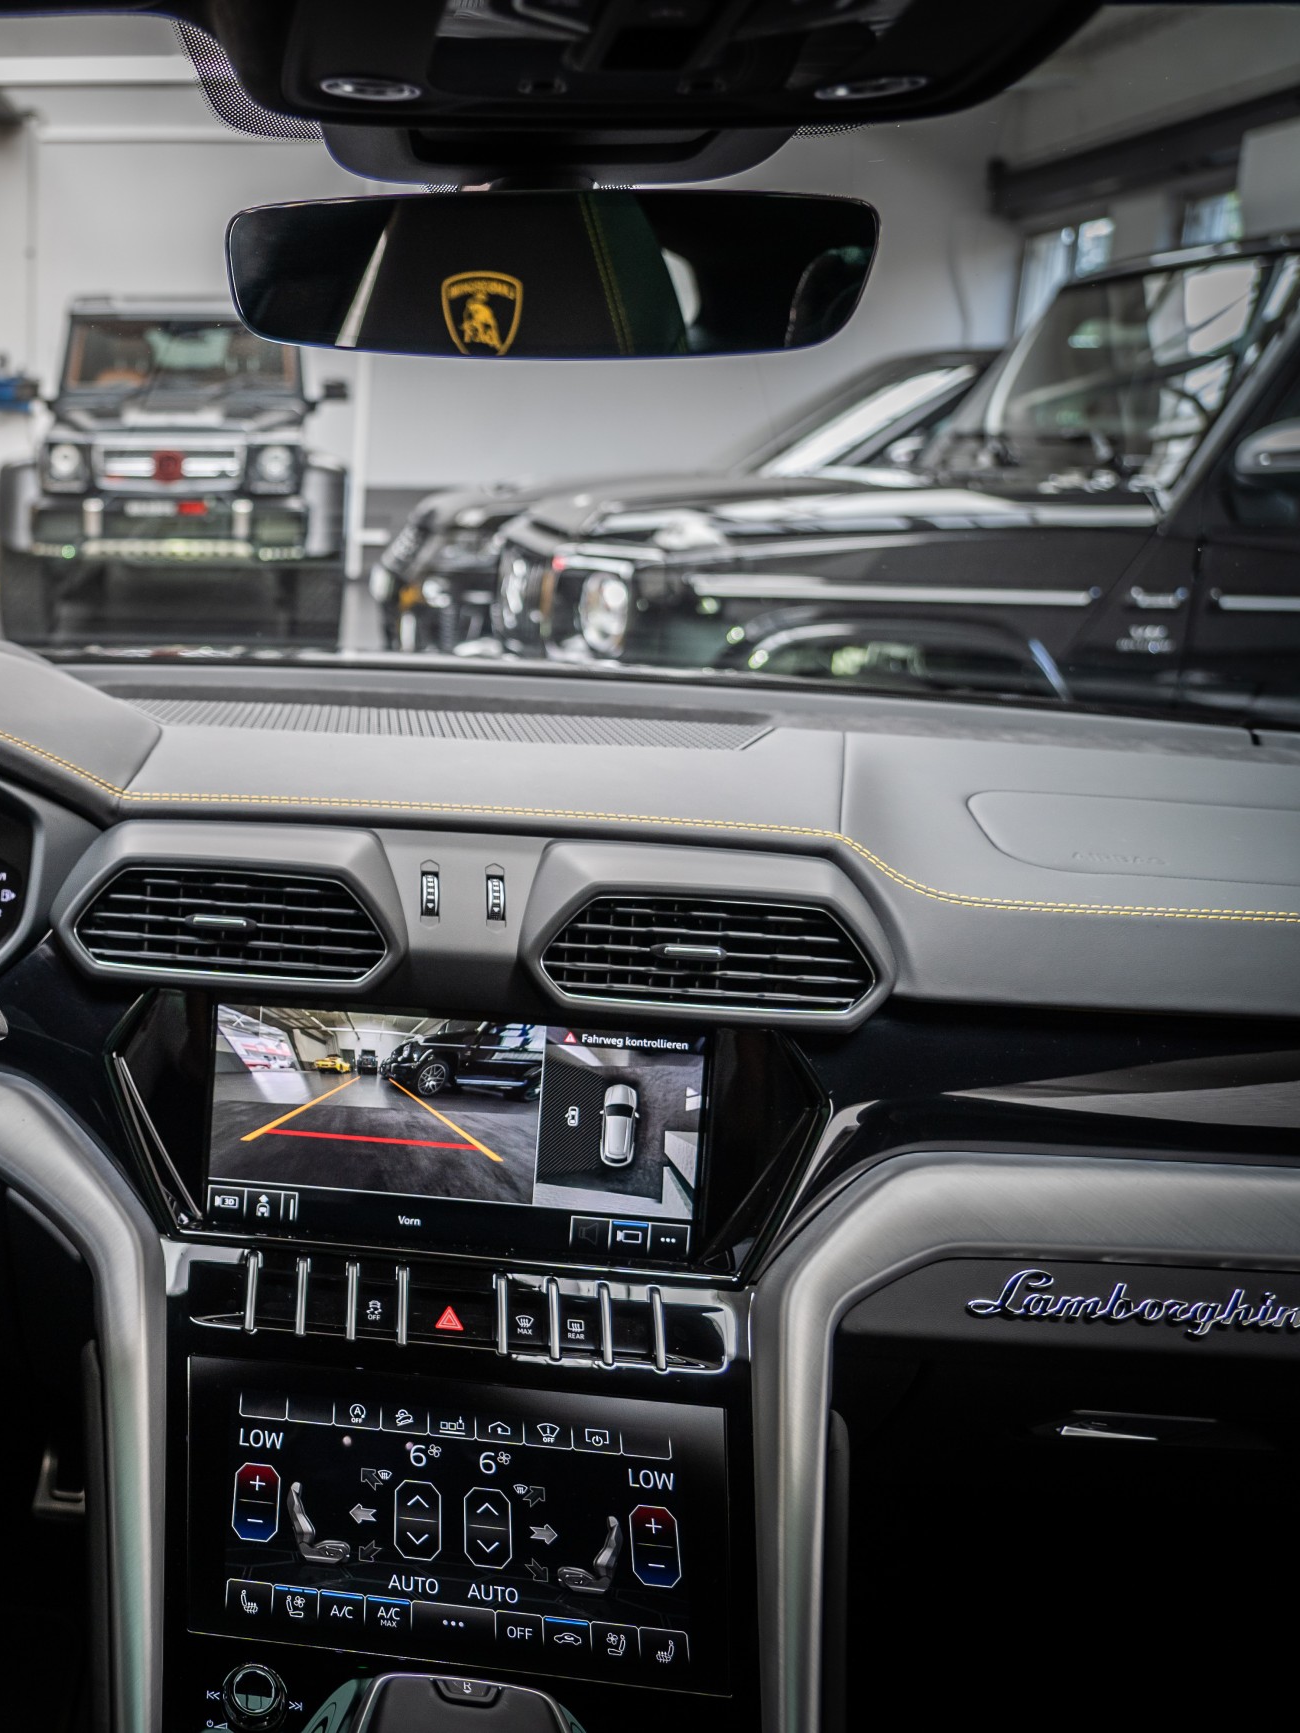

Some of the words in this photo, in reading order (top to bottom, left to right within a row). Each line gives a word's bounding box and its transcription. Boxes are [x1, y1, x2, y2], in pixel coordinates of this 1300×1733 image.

[581, 1033, 624, 1048] Fahrweg
[625, 1036, 689, 1050] kontrollieren
[398, 1215, 421, 1226] Vorn
[367, 1313, 381, 1321] OFF
[517, 1327, 533, 1336] MAX
[567, 1332, 585, 1340] REAR
[239, 1427, 284, 1450] LOW
[409, 1444, 427, 1467] 6
[479, 1451, 496, 1474] 6
[628, 1468, 674, 1491] LOW
[388, 1574, 439, 1595] AUTO
[467, 1583, 519, 1604] AUTO
[330, 1604, 354, 1619] A/C
[377, 1606, 401, 1621] A/C
[380, 1619, 397, 1629] MAX
[506, 1625, 533, 1640] OFF
[463, 1681, 472, 1690] R
